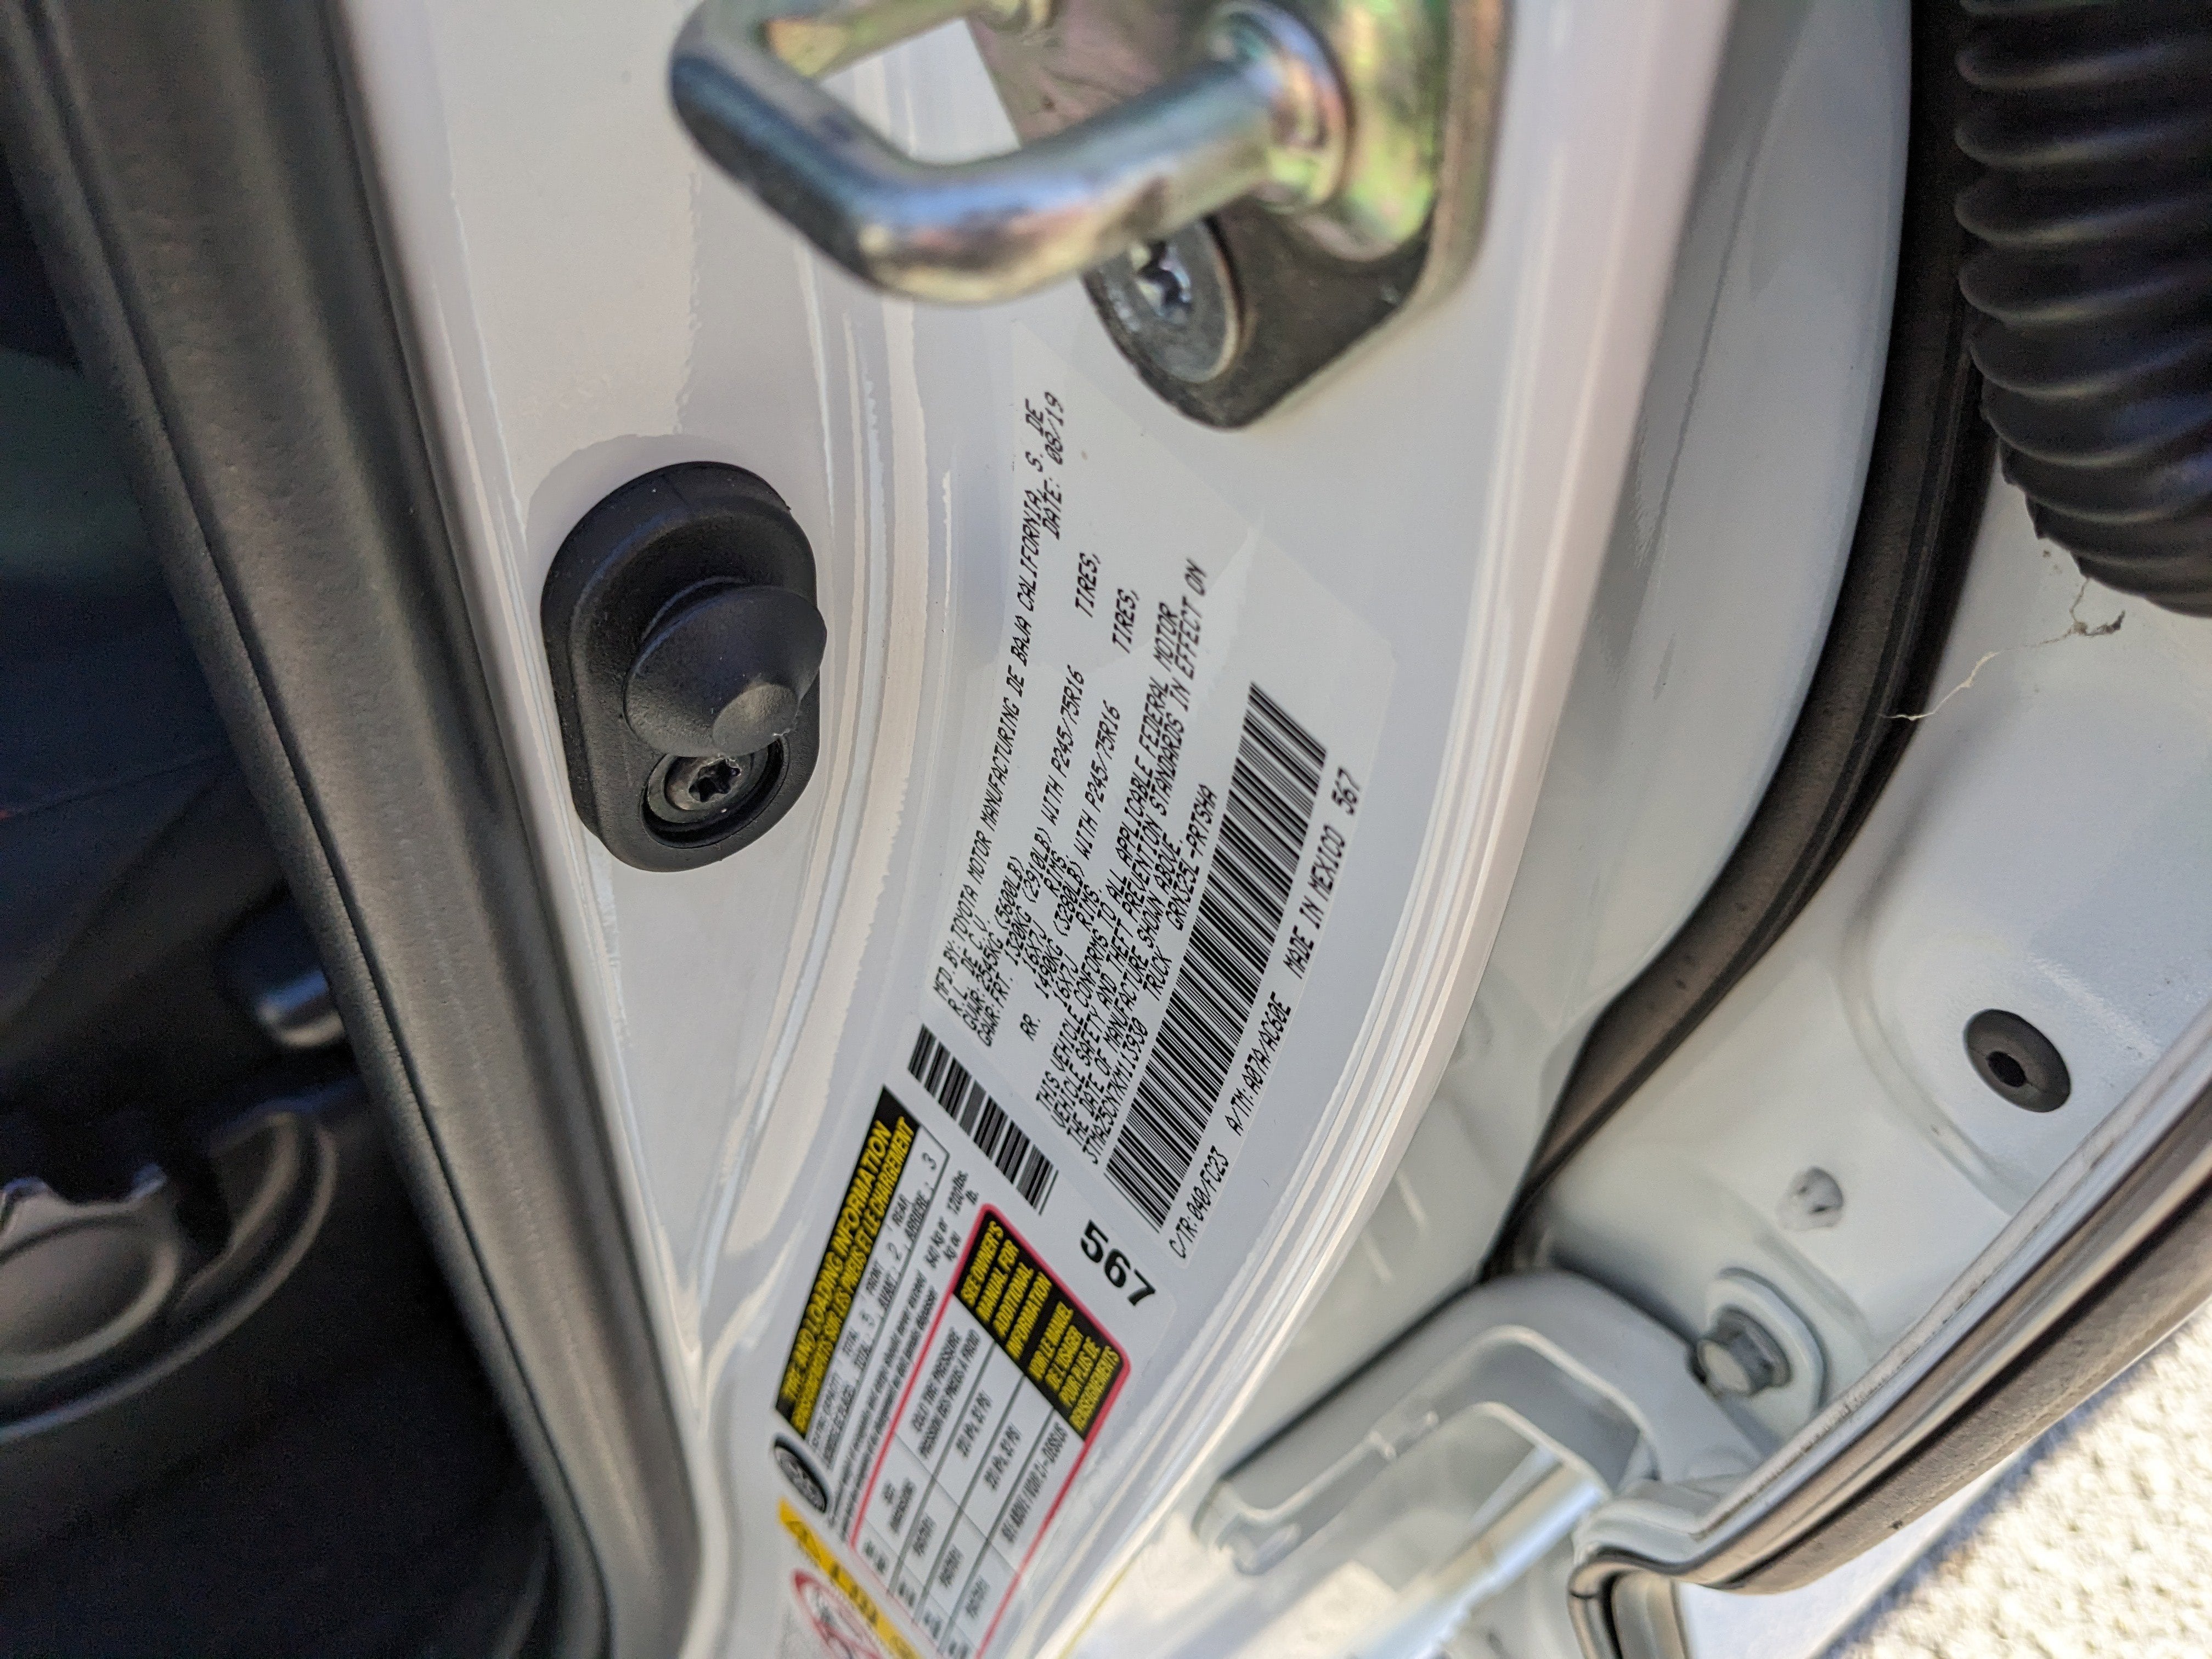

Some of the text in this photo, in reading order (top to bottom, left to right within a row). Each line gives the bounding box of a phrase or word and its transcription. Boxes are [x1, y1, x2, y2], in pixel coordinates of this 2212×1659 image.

[1025, 398, 1045, 436] DE
[1025, 450, 1043, 472] S.
[1042, 391, 1063, 540] DATE: 08/19
[1018, 489, 1045, 612] CALIFORNIA,
[1075, 552, 1101, 617] TIRES,
[1011, 614, 1032, 666] BAJA
[1005, 665, 1025, 697] DE
[1051, 664, 1086, 778] P245/75R16
[980, 697, 1020, 831] MANUFACTURING
[1041, 774, 1065, 826] WITH
[1331, 766, 1361, 816] 567
[1019, 589, 1139, 1041] RR. 1490KG (3280LB) WITH P245/75R16 TIRES,
[1050, 558, 1207, 1128] VEHICLE SAFETY AND THEFT PREVENTION STANDARDS IN EFFECT ON
[965, 830, 992, 884] MOTOR
[993, 855, 1025, 930] (5600LB)
[1020, 827, 1053, 903] (2910LB)
[1035, 601, 1178, 1111] THIS VEHICLE CONFORMS TO ALL APPLICABLE FEDERAL MOTOR
[1307, 823, 1346, 901] MEXICO
[1003, 905, 1032, 966] 1320KG
[1022, 850, 1069, 973] 16X7J RIMS.
[1052, 883, 1102, 1008] 16X7J RIMS.
[1298, 895, 1323, 929] IN
[946, 914, 991, 1017] R.L. DE C.V.
[1066, 832, 1183, 1145] THE DATE OF MANUFACTURE SHOWN ABOVE.
[1142, 945, 1172, 1001] TRUCK
[1281, 924, 1314, 980] MADE
[832, 1119, 893, 1257] INFORMATION
[870, 1115, 916, 1217] CHARGEMENT
[922, 1150, 937, 1170] 3
[856, 1226, 874, 1254] ET
[862, 1207, 882, 1238] LE
[803, 1250, 845, 1335] LOADING
[840, 1245, 867, 1294] PNEUS
[961, 1219, 1006, 1306] SEE OWNER'S
[976, 1239, 1020, 1323] MANUAL FOR
[994, 1261, 1035, 1338] ADDITIONAL
[1081, 1219, 1155, 1305] 567
[794, 1327, 815, 1368] AND
[1006, 1271, 1054, 1362] INFORMATION
[1039, 1336, 1056, 1359] LE
[1045, 1300, 1074, 1348] MANUEL
[1059, 1373, 1082, 1408] POUR
[1082, 1335, 1102, 1361] DE
